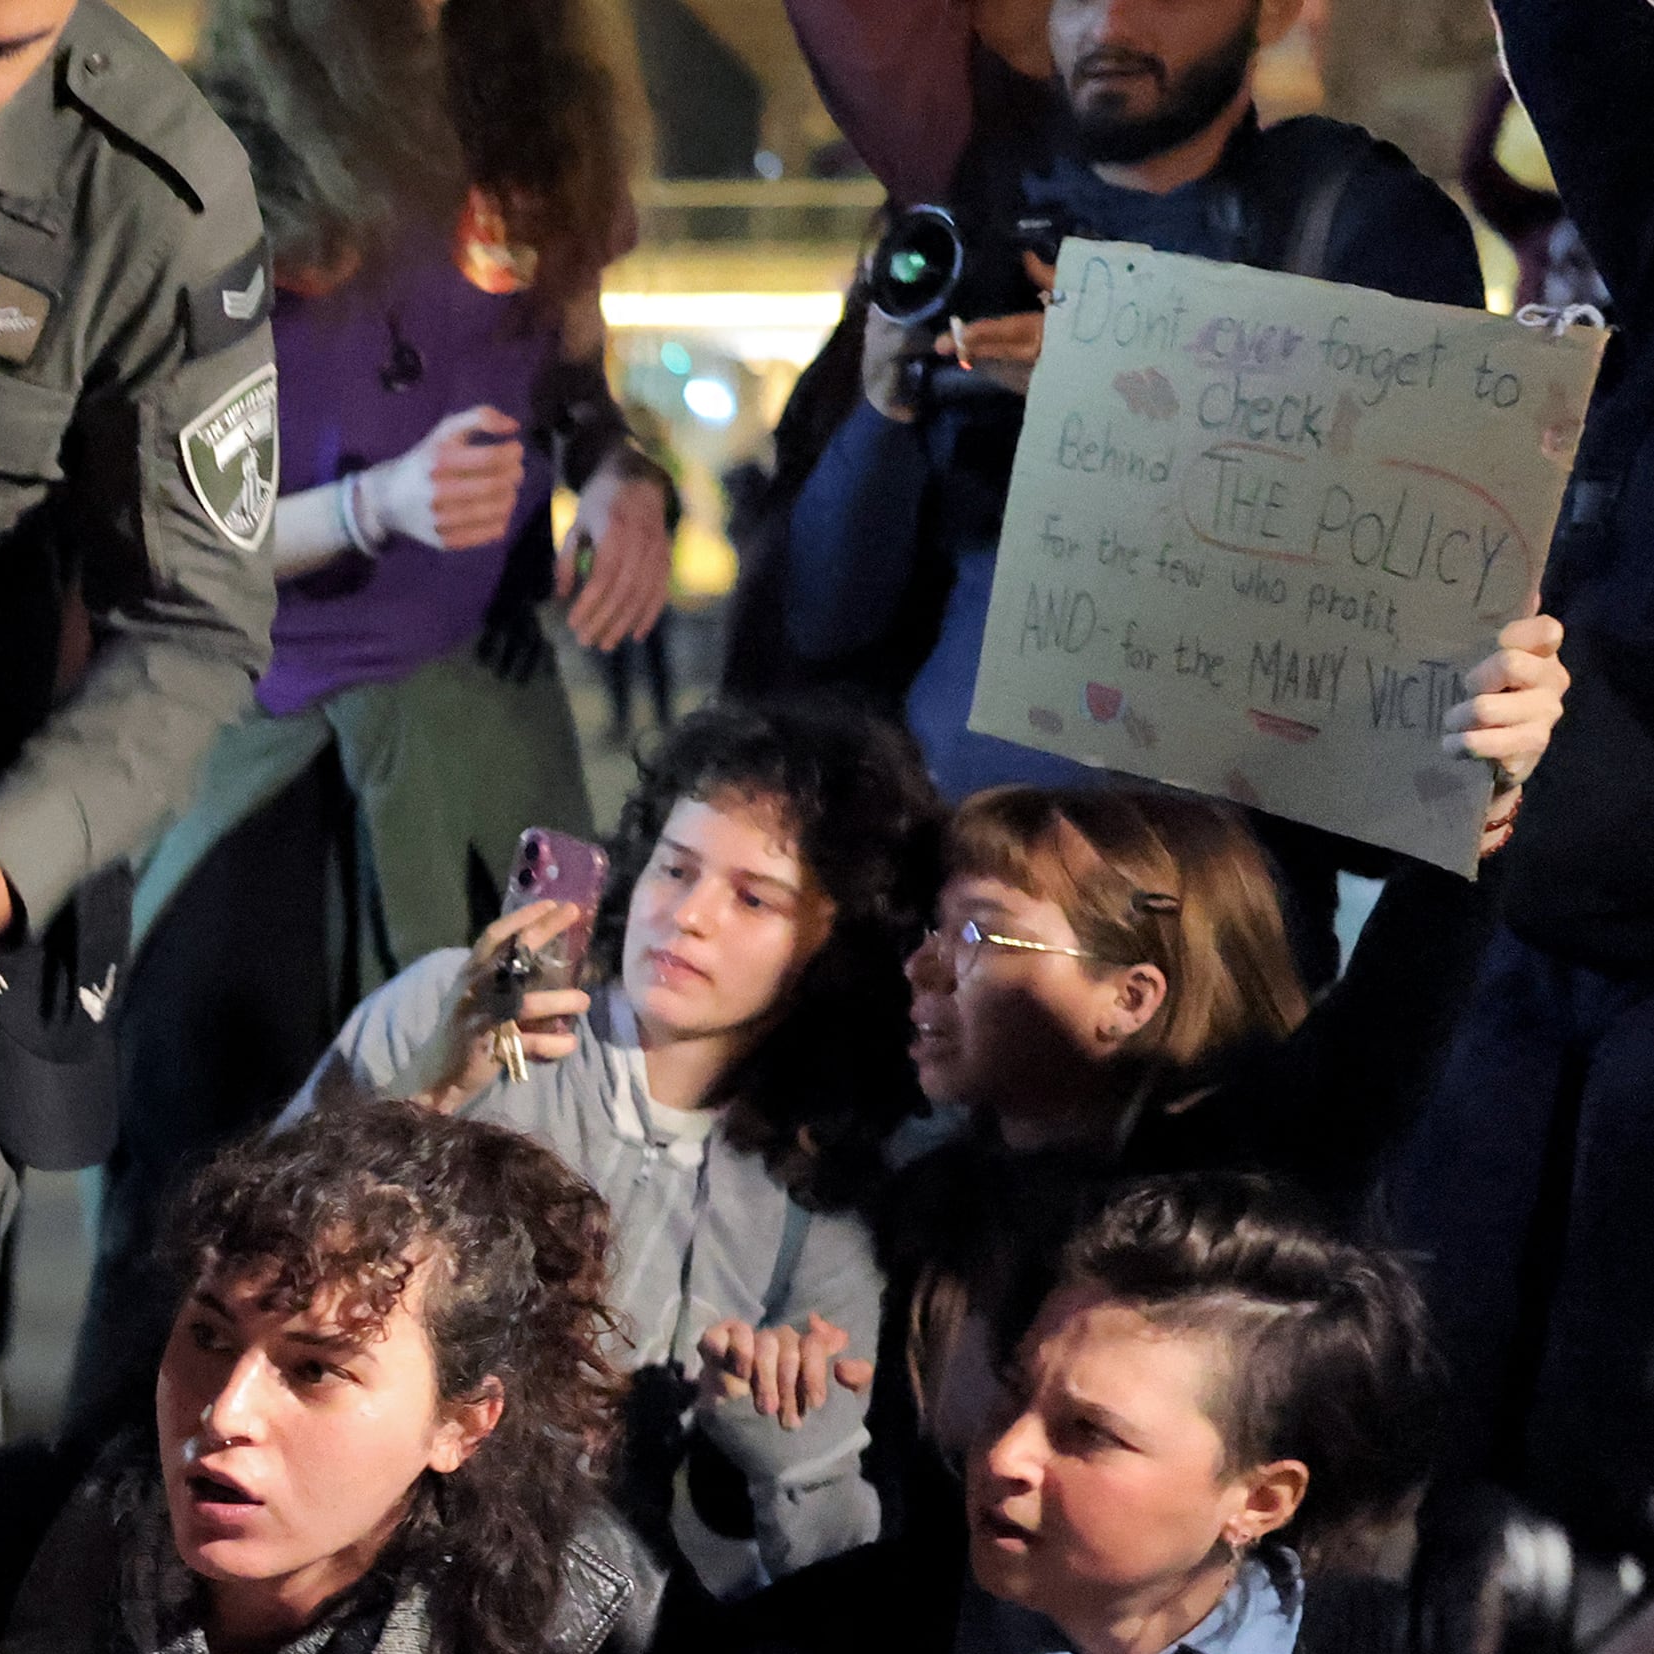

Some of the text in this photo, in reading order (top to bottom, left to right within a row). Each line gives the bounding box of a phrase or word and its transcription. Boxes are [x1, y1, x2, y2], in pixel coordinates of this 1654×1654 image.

[1319, 315, 1447, 407] forget
[1475, 353, 1520, 409] to
[1057, 411, 1509, 608] Behind THE POLICY
[1156, 541, 1207, 589] few
[1232, 561, 1287, 604] who
[1121, 621, 1159, 671] for
[1175, 635, 1224, 688] the
[1247, 639, 1348, 714] MANY
